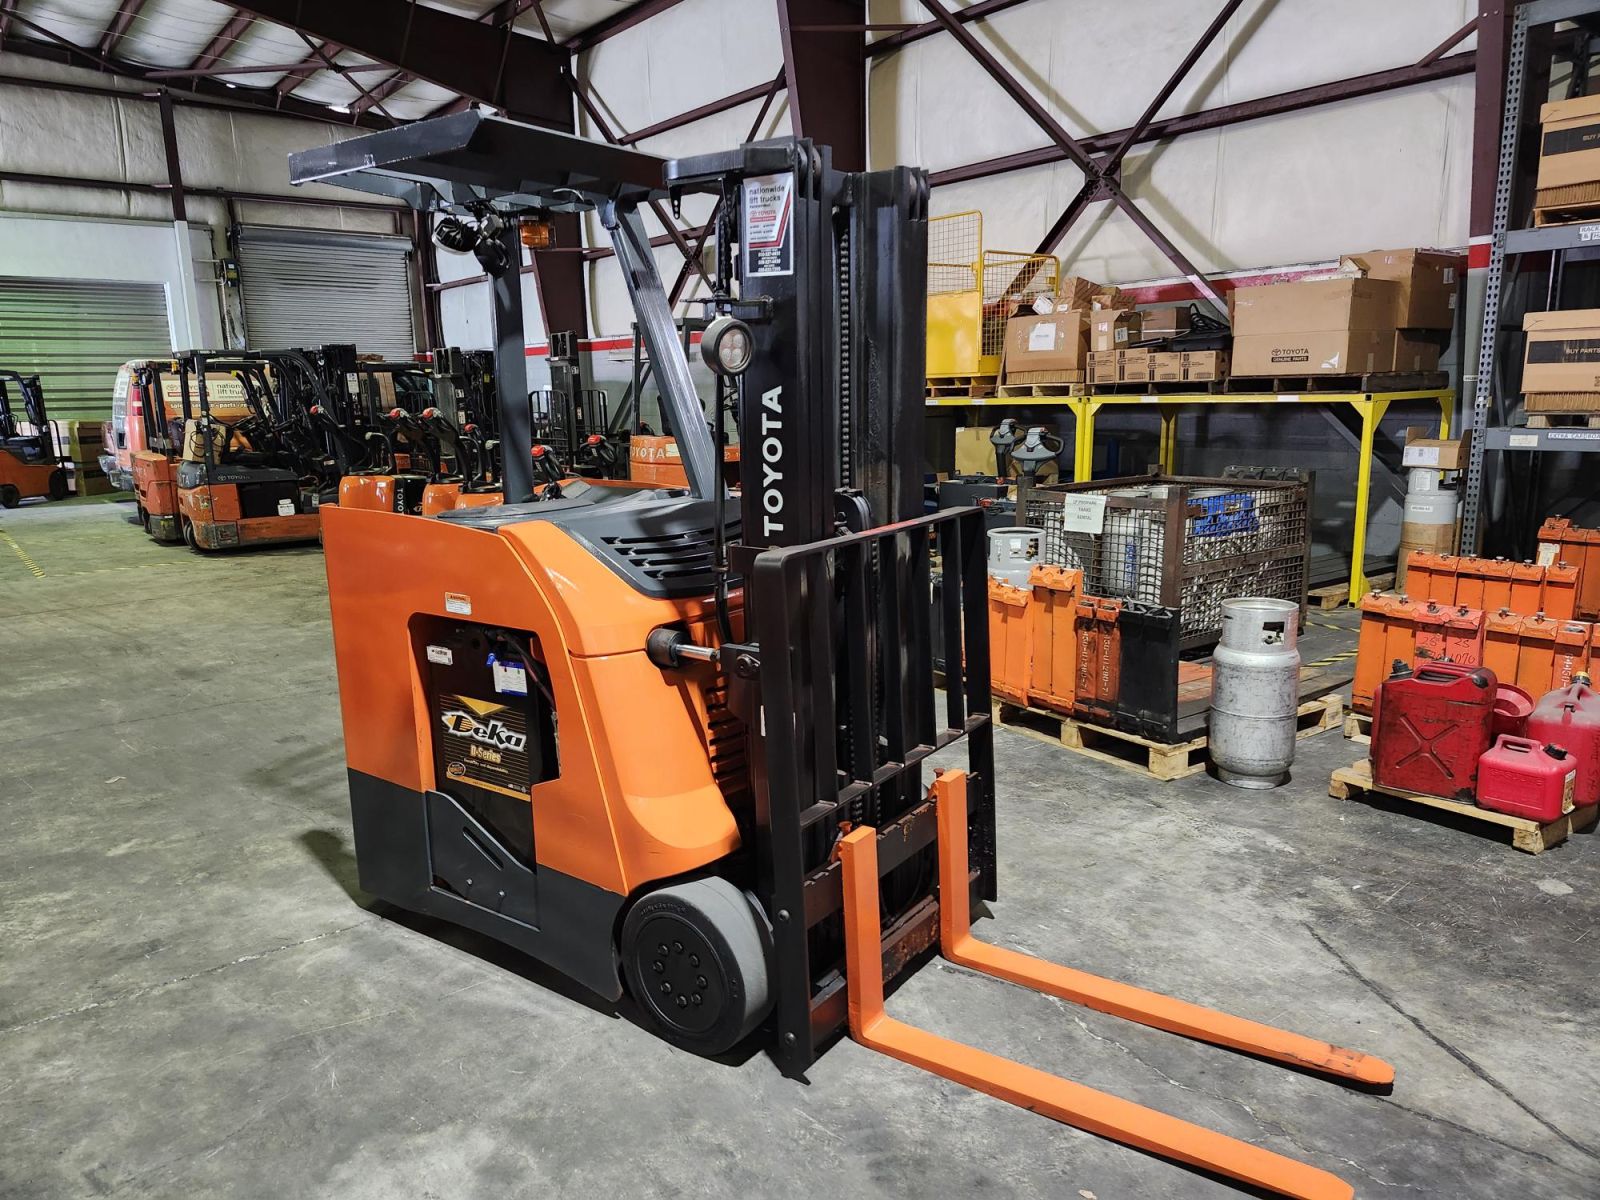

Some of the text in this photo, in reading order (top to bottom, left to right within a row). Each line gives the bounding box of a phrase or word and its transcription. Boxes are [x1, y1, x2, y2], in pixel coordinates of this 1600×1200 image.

[749, 185, 785, 195] nationwide
[749, 195, 781, 205] lift trucks
[762, 386, 784, 537] TOYOTA
[443, 712, 525, 750] Deka
